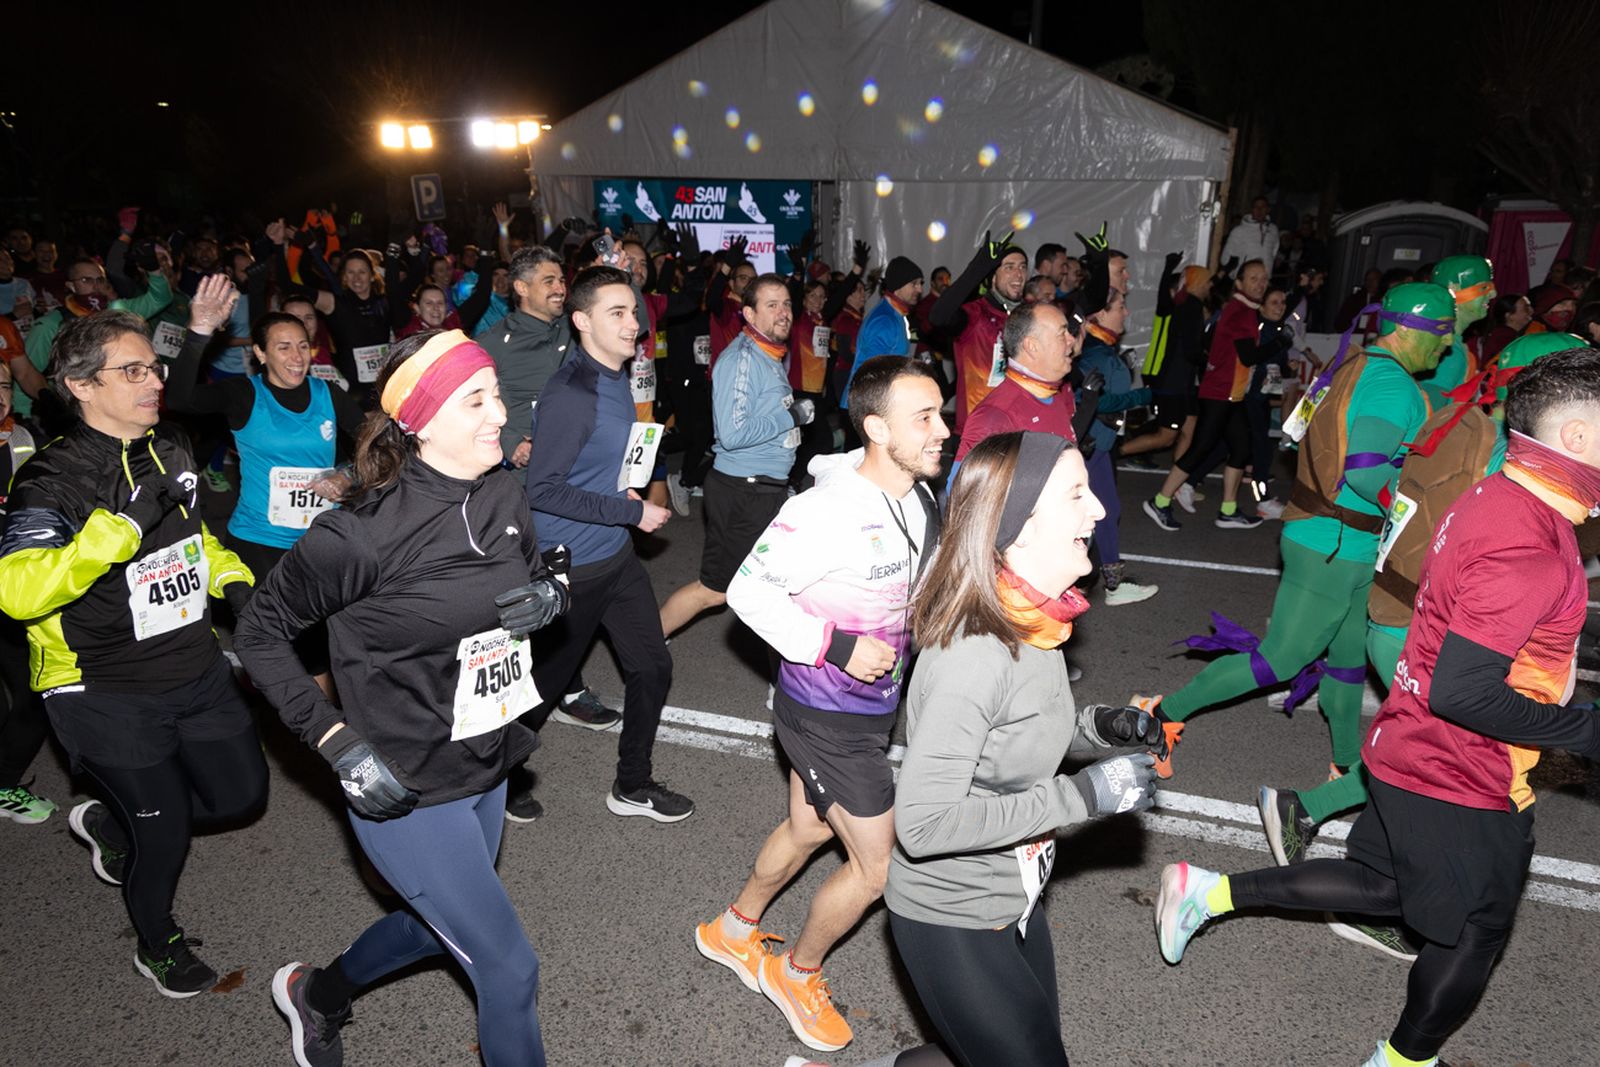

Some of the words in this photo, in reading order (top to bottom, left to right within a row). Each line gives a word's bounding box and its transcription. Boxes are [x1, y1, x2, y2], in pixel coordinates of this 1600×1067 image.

[675, 186, 695, 204] 43
[694, 186, 728, 203] SAN
[671, 201, 725, 220] ANTÓN
[148, 567, 201, 606] 4505
[473, 650, 523, 698] 4506
